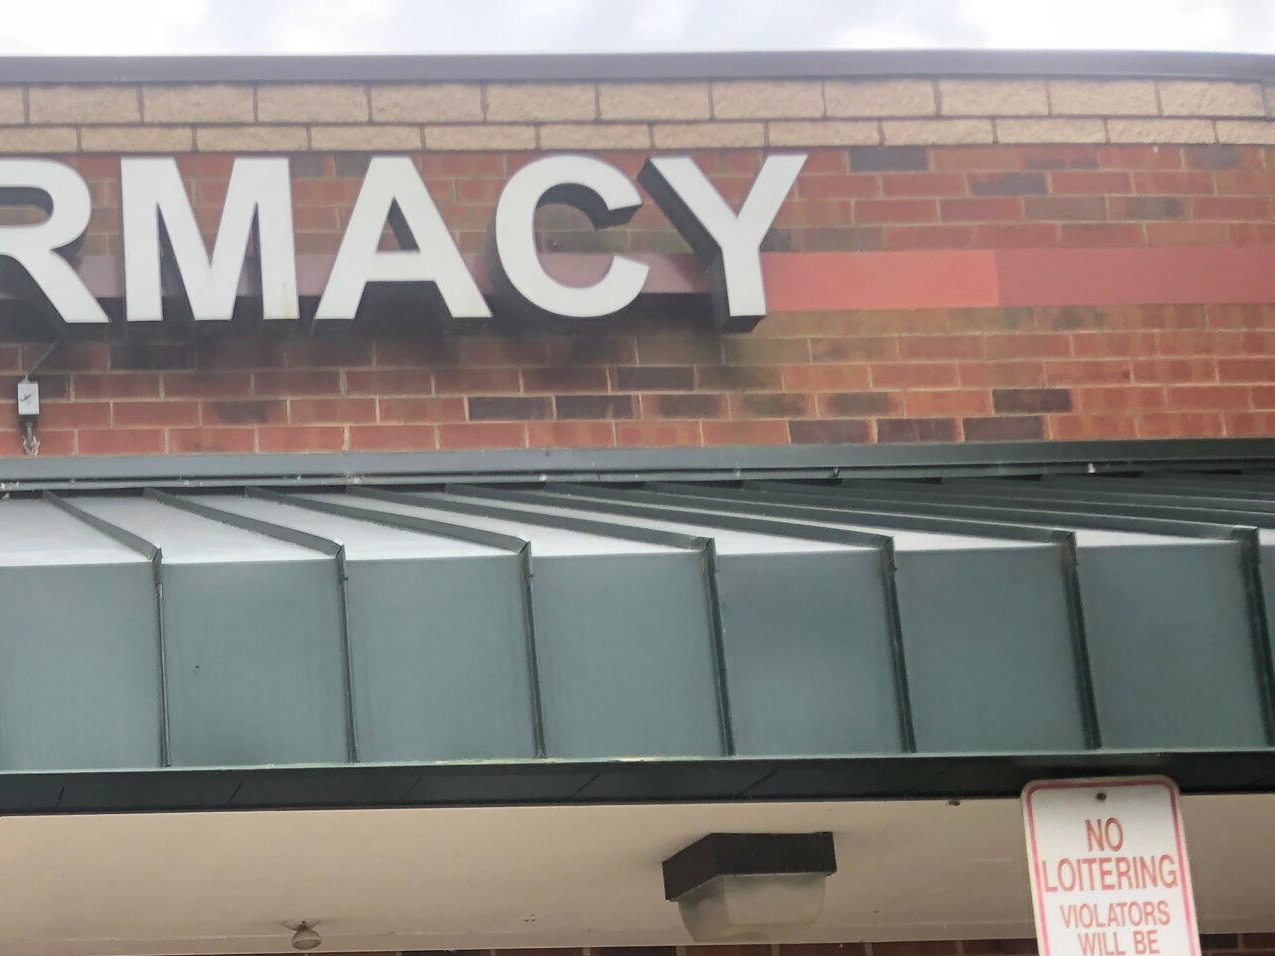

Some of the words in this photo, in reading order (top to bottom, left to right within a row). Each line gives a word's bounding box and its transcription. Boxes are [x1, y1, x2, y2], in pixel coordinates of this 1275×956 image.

[1085, 817, 1124, 852] NO
[1041, 854, 1178, 893] LOITERING
[1059, 900, 1171, 929] VIOLATORS
[1077, 932, 1126, 956] WILL
[1132, 930, 1161, 955] BE
